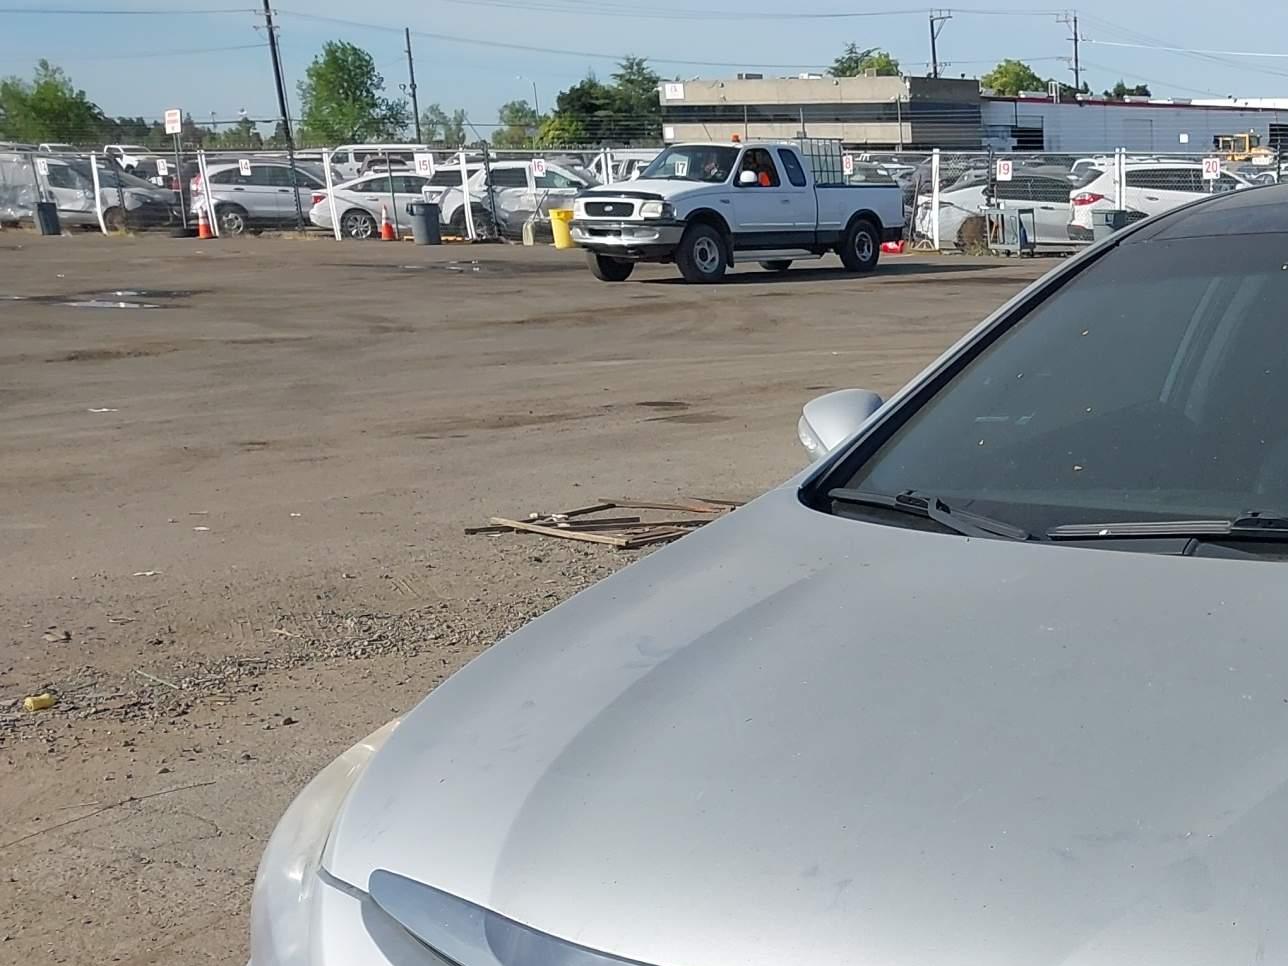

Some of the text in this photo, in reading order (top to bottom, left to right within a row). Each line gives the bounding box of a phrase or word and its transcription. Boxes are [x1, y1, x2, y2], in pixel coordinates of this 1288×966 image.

[240, 160, 249, 171] 14
[419, 160, 428, 171] 15
[533, 160, 544, 172] 16
[676, 162, 686, 173] 17
[998, 163, 1010, 176] 19
[1205, 161, 1218, 173] 20
